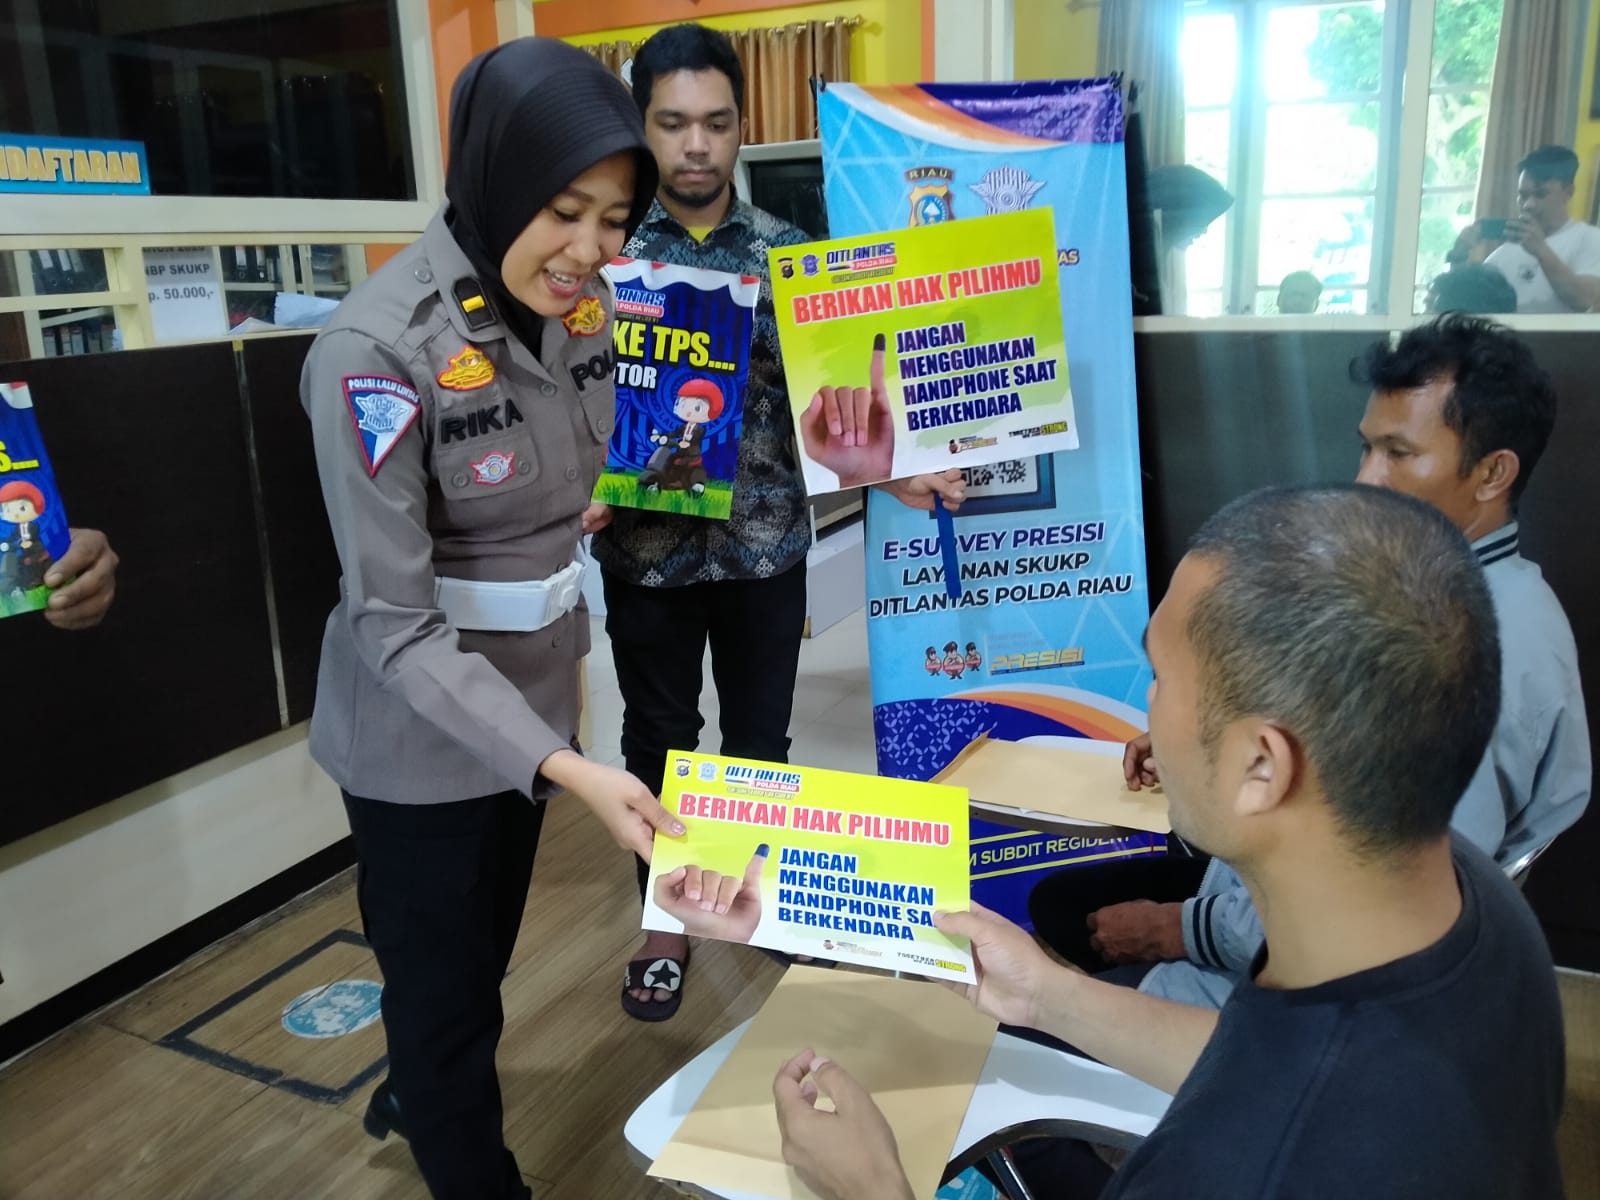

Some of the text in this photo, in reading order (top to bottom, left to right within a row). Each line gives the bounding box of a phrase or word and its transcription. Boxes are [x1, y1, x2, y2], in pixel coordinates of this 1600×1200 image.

[908, 167, 949, 180] RIAU
[169, 263, 211, 275] SKUKP
[1057, 249, 1080, 266] AS
[615, 286, 665, 307] ANTAS
[620, 302, 642, 312] POLDA
[791, 282, 894, 325] BERIKAN
[896, 272, 946, 307] HAK
[947, 258, 1042, 299] PILIHMU
[895, 320, 967, 354] JANGAN
[612, 361, 658, 389] TOR
[898, 336, 1036, 380] MENGGUNAKAN
[348, 378, 376, 391] POLISI
[376, 379, 398, 391] LALU
[902, 358, 1058, 406] HANDPHONE SAAT
[440, 398, 524, 445] RIKA
[906, 392, 1023, 432] BERKENDARA
[883, 522, 1105, 561] E-SUVEY PRESISI
[902, 552, 1091, 587] LAYNAN SKUKP
[994, 582, 1072, 605] POLDA
[1076, 574, 1133, 597] RIAU
[991, 647, 1085, 672] PRESISI
[678, 793, 787, 828] BERIKAN
[792, 807, 843, 835] HAK
[848, 813, 951, 846] PILIHMU
[779, 847, 857, 874] JANGAN
[980, 842, 1043, 865] SUBDIT
[778, 869, 934, 907] MENGGUNAKAN
[778, 888, 934, 928] HANDPHONE SA
[778, 907, 915, 941] BERKENDARA
